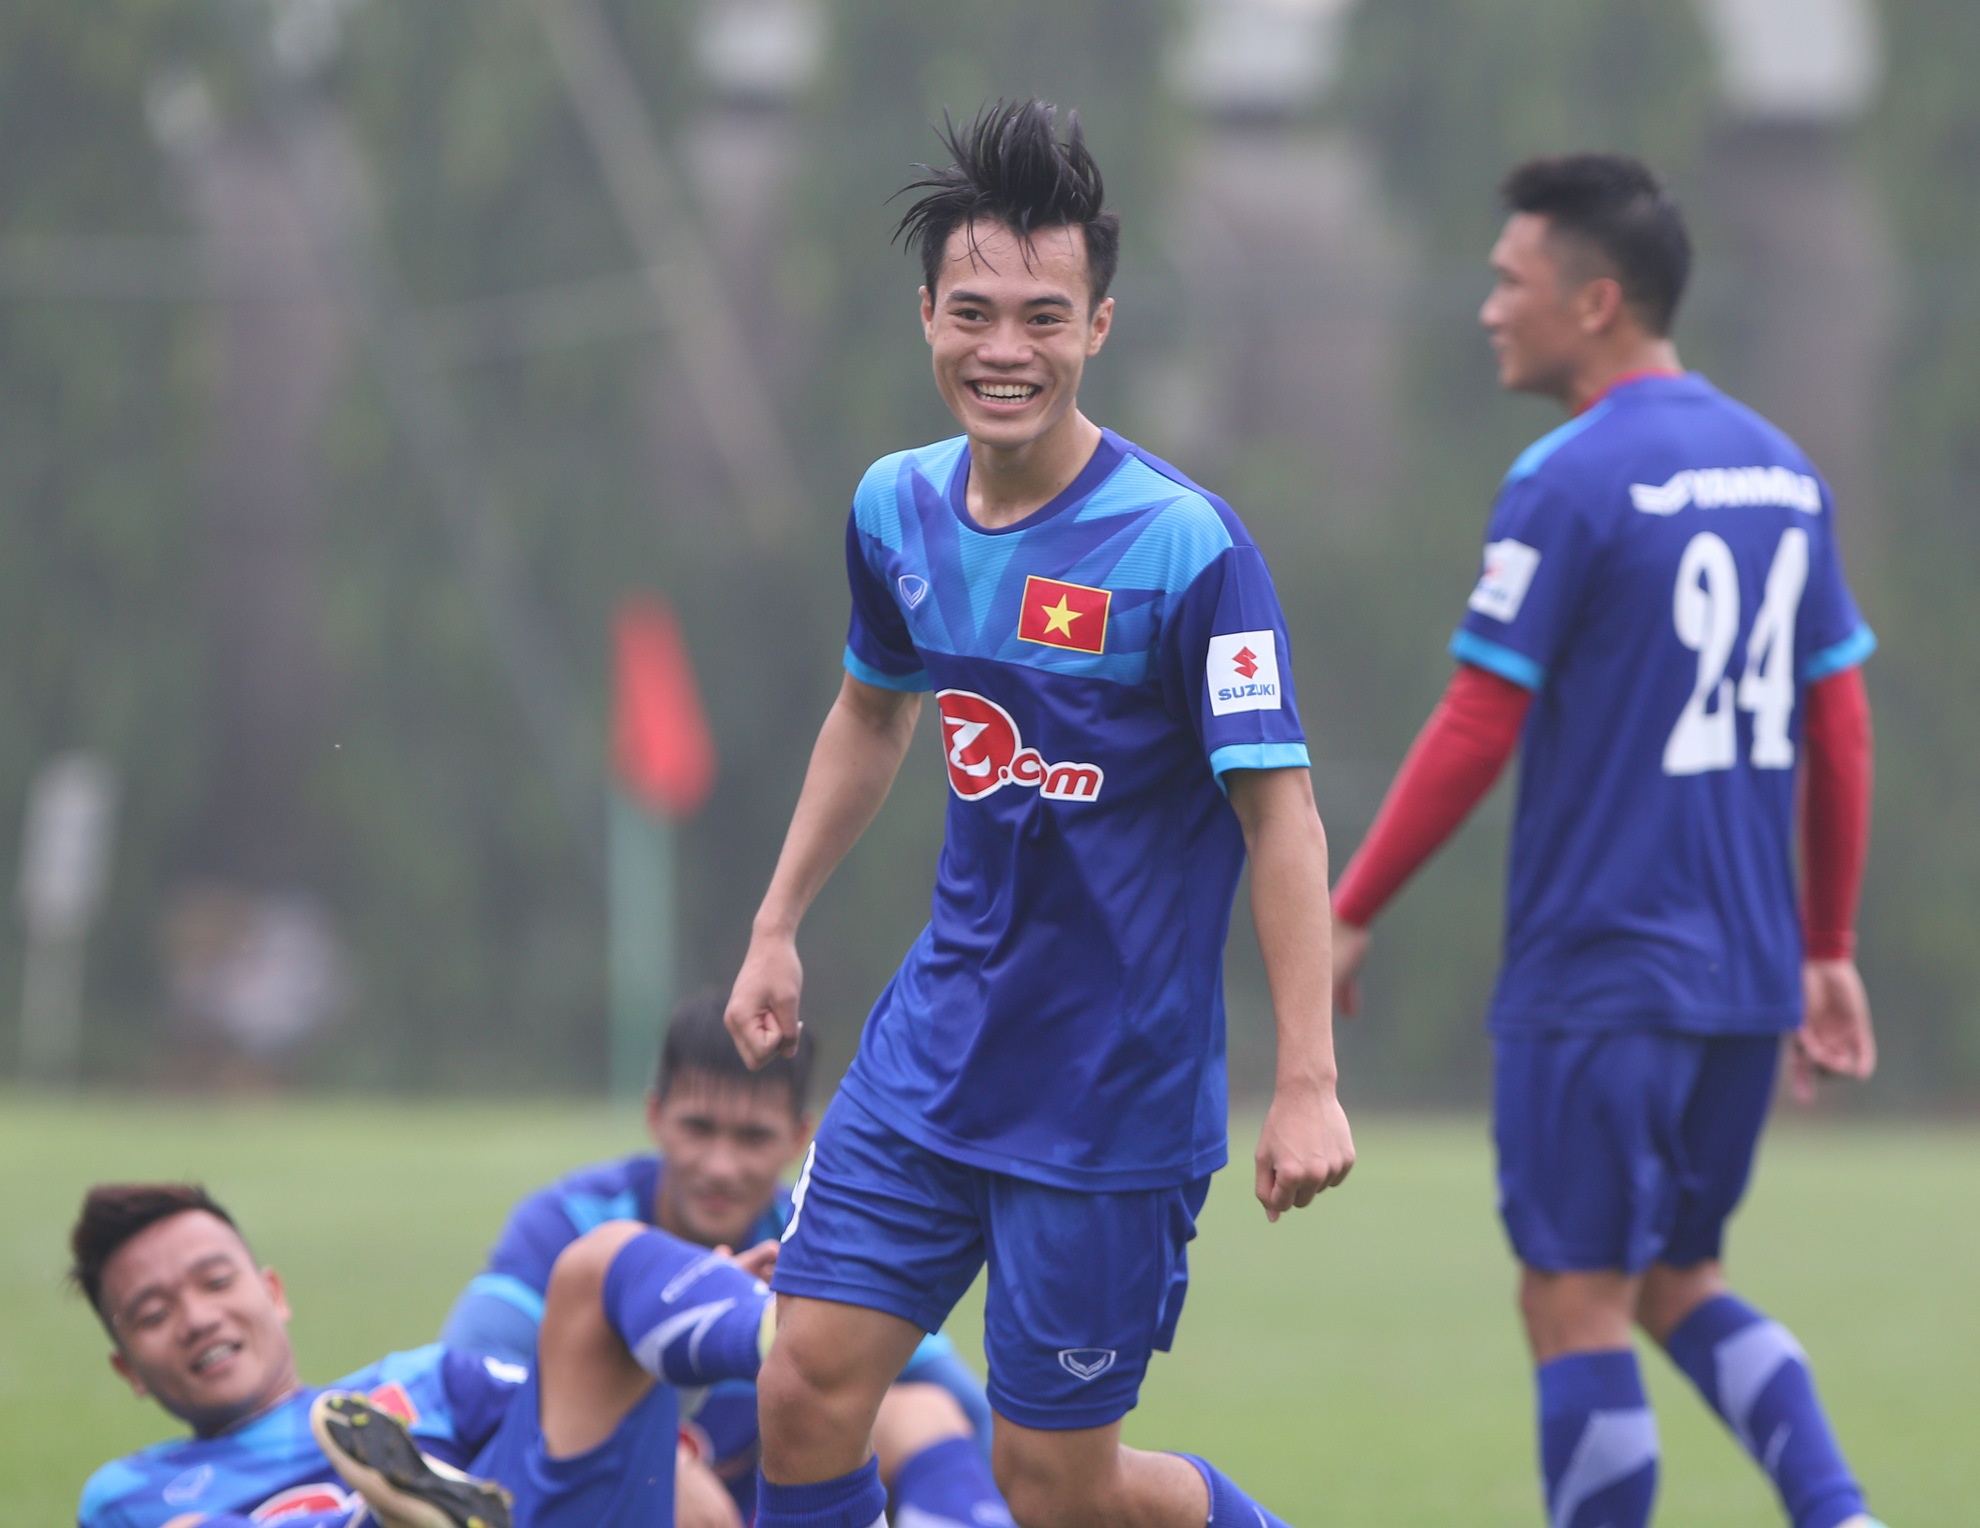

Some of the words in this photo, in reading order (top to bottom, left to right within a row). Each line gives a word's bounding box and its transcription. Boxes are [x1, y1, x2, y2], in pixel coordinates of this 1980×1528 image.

[1218, 684, 1275, 700] SUZUKI
[1663, 527, 1808, 774] 24
[940, 702, 1103, 800] Z.cm
